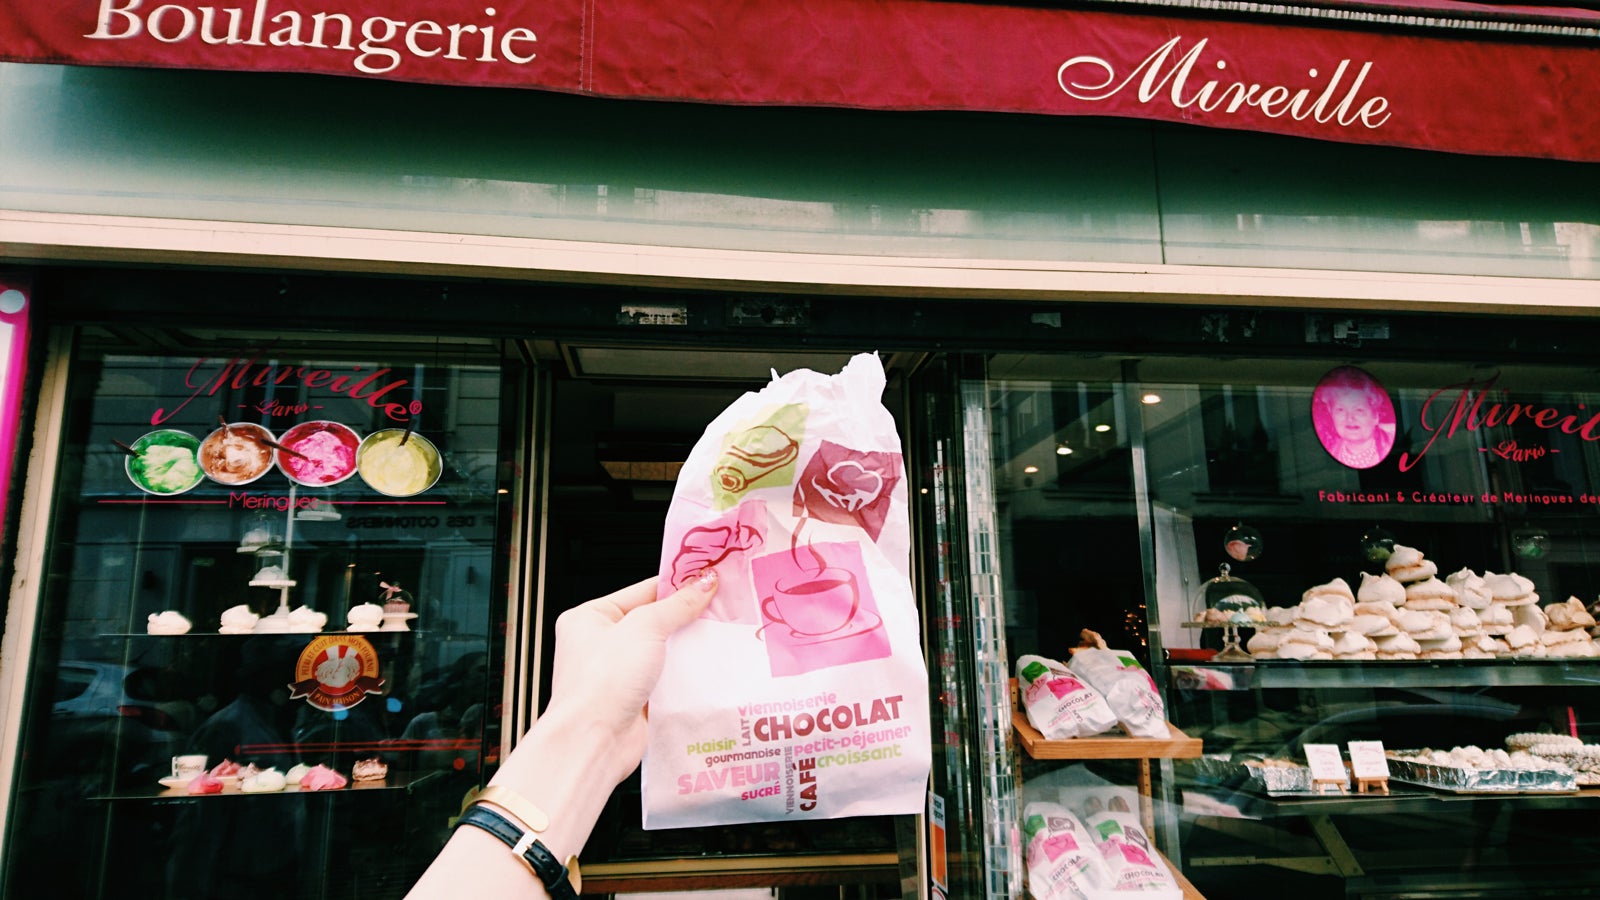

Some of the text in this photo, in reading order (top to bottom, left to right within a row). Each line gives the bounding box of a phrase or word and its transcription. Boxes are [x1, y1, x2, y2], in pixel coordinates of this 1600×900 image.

[83, 0, 537, 74] Boulangerie
[1057, 35, 1392, 129] Mireille
[256, 399, 309, 417] Paris
[1491, 440, 1547, 462] Paris
[229, 491, 320, 511] Meringues
[1318, 490, 1390, 503] Fabricant
[1396, 490, 1406, 503] &
[1412, 490, 1475, 503] Créateur
[1481, 491, 1499, 503] de
[1503, 491, 1574, 505] Meringues
[314, 691, 361, 705] PAIN MAISON
[736, 691, 838, 717] viennoiserie
[753, 695, 903, 742] CHOCOLAT
[740, 718, 751, 747] LAIT
[817, 743, 902, 768] croissant
[677, 762, 781, 796] SAVEUR
[741, 780, 782, 801] SUCRÉ
[785, 746, 795, 815] VIENNOISERIE
[791, 757, 818, 811] CAFÉ
